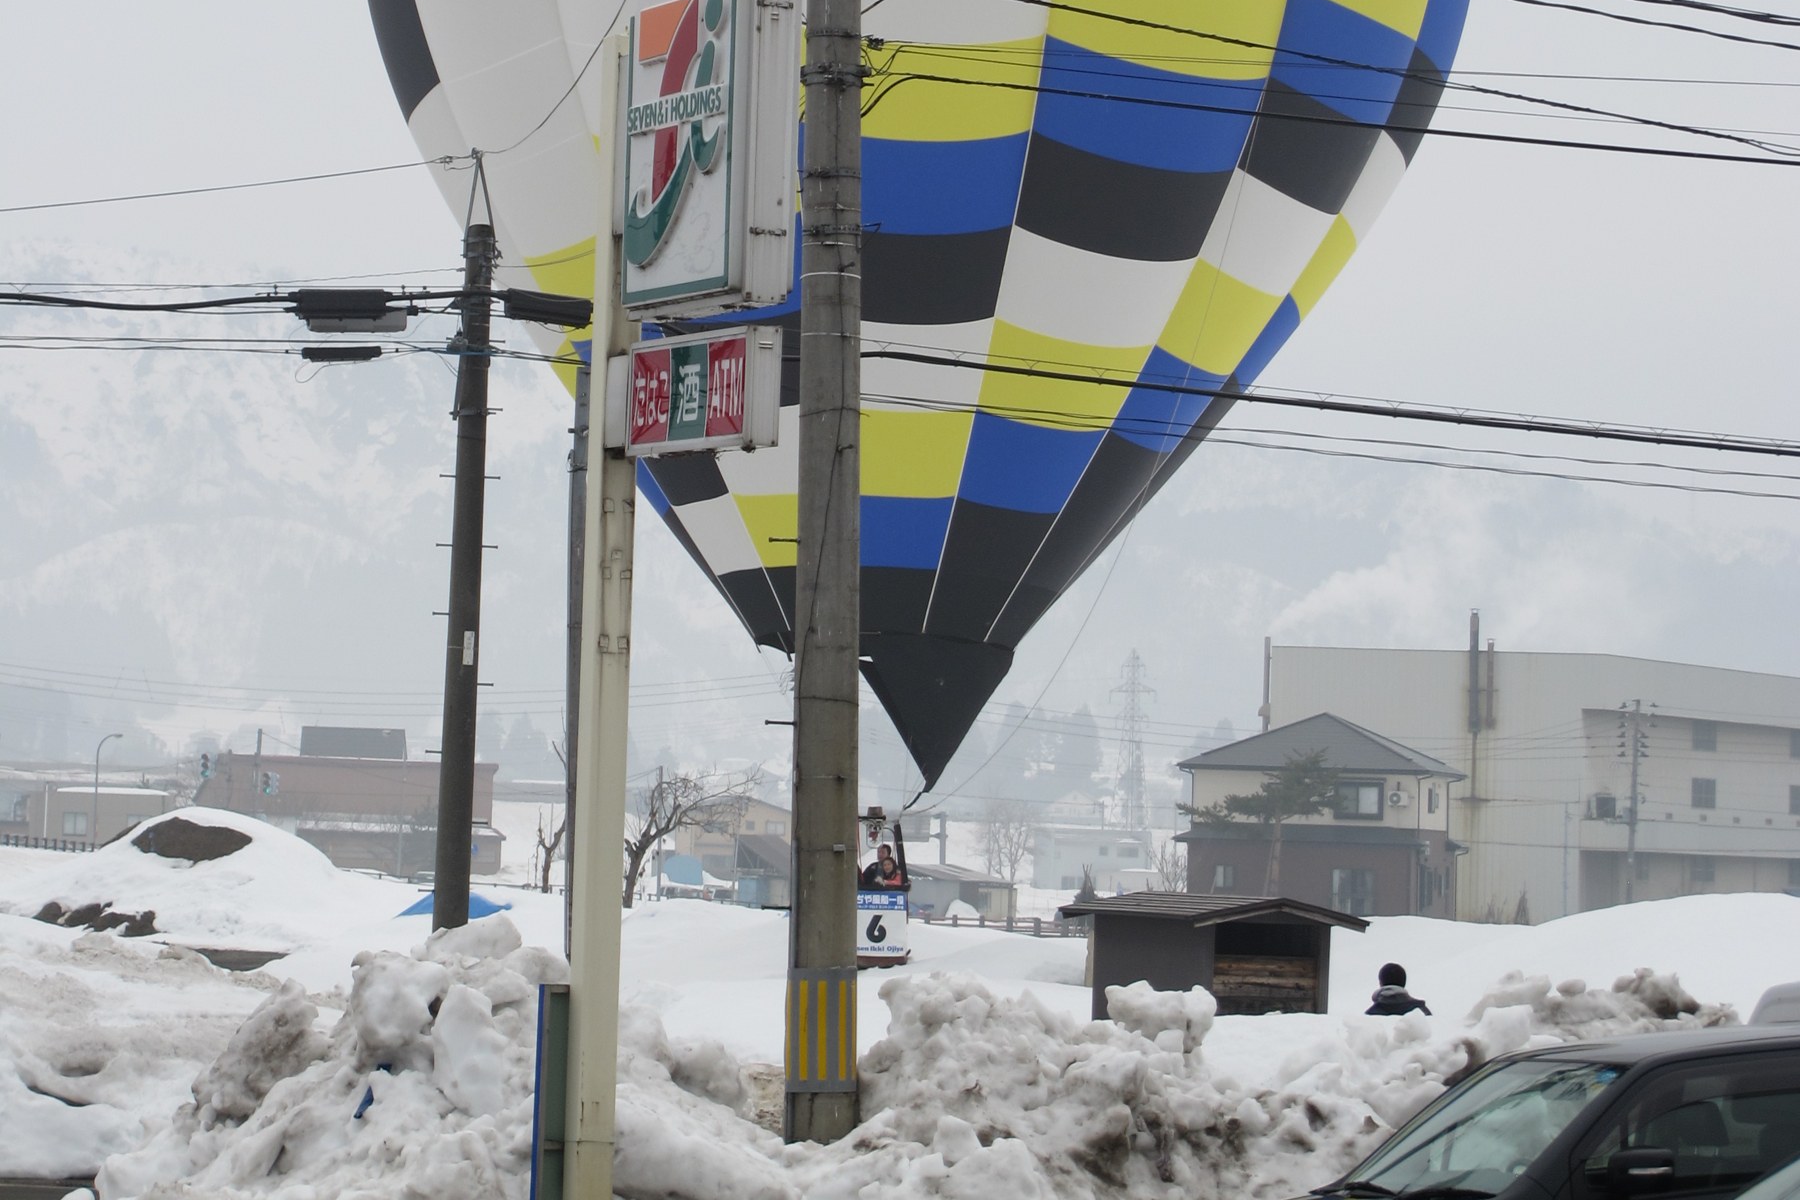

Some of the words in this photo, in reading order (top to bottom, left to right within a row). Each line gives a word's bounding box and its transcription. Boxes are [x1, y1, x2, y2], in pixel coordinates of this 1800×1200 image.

[671, 86, 721, 122] HOLDINGS
[677, 363, 701, 425] 酒
[709, 357, 743, 419] ATM
[866, 914, 887, 944] 6
